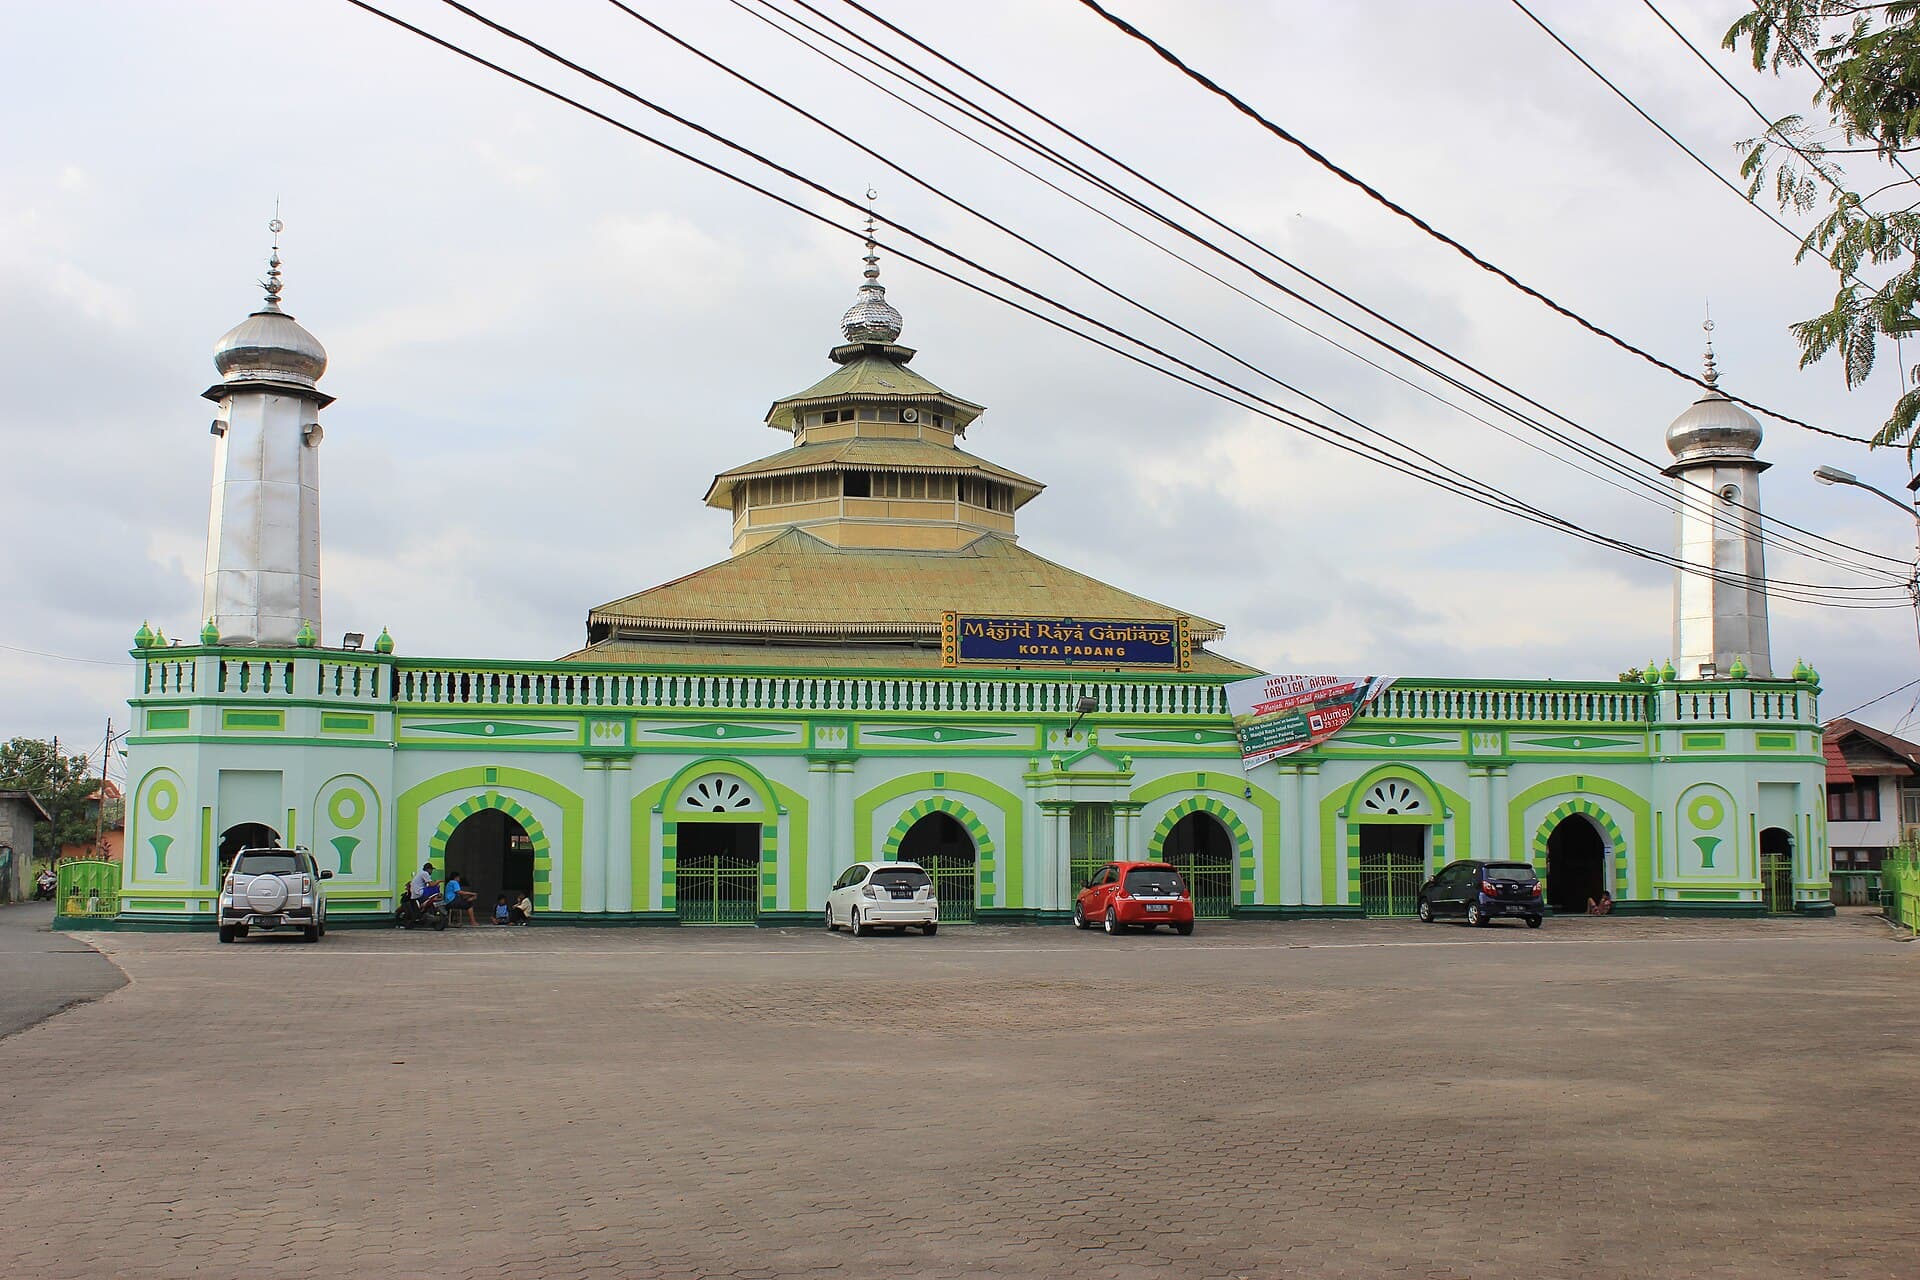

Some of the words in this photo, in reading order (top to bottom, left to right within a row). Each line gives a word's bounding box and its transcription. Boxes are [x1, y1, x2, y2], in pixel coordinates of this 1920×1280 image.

[963, 621, 1032, 641] Masjid
[1037, 623, 1084, 641] Raya
[1019, 645, 1059, 655] KOTA
[1064, 645, 1126, 657] PADANG
[1322, 707, 1351, 721] Jum'at
